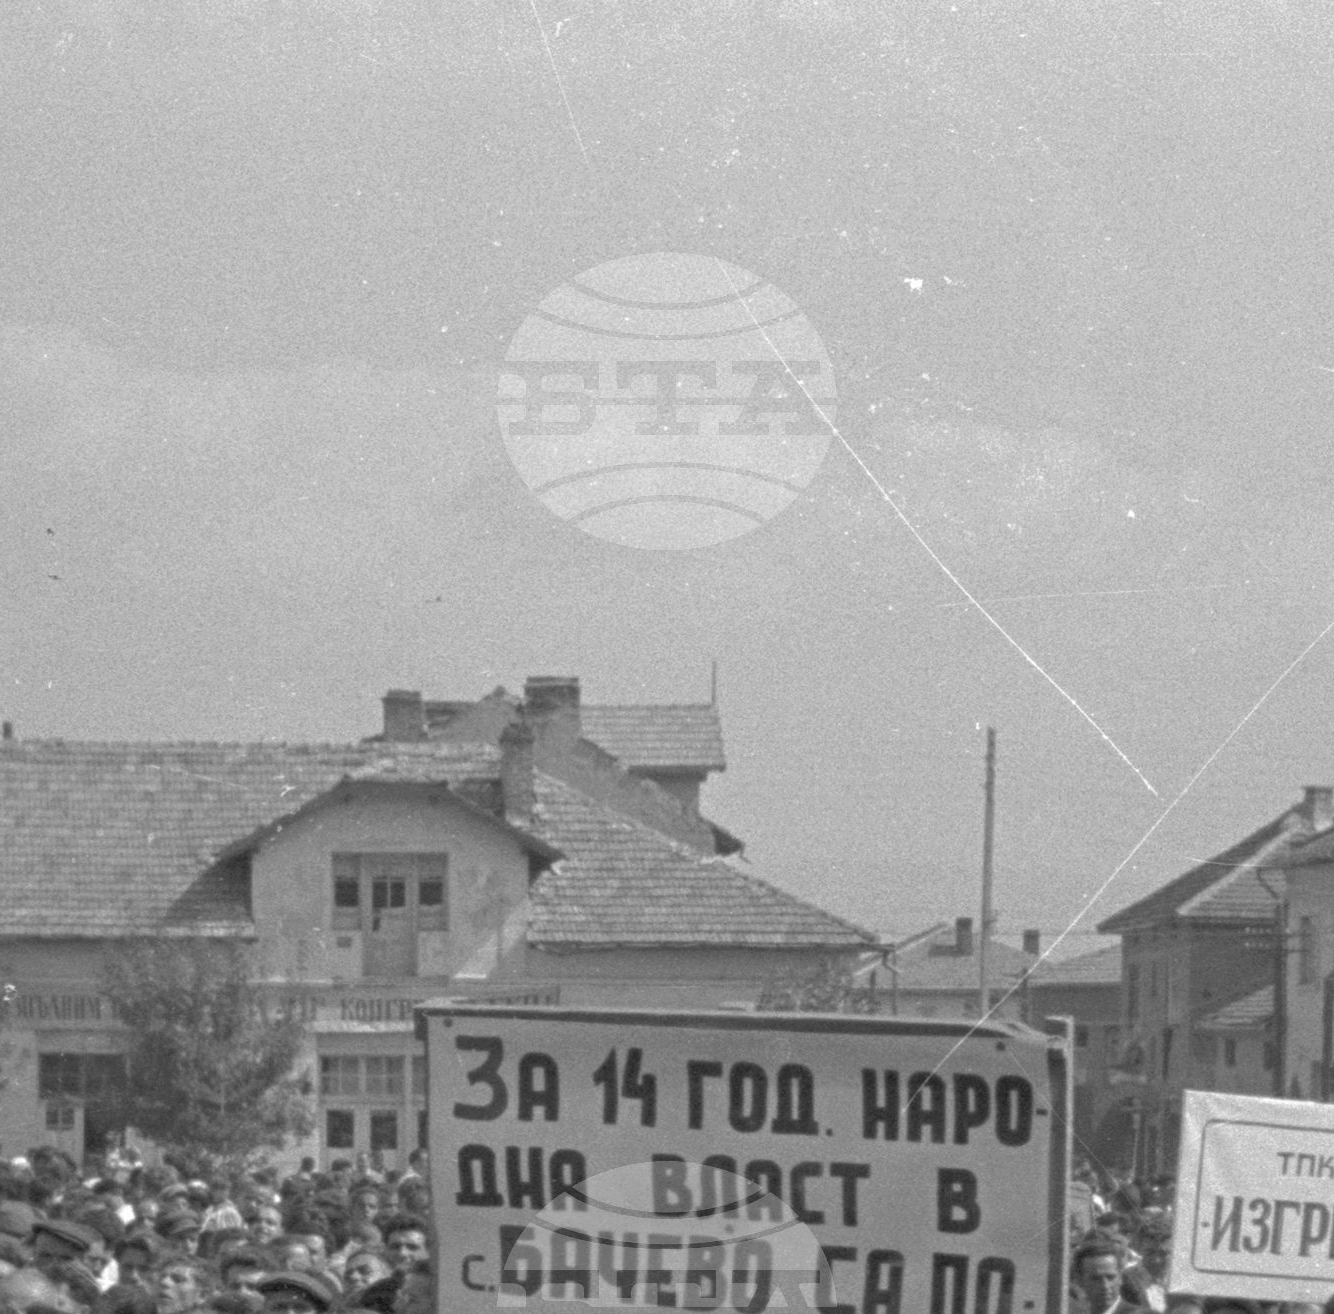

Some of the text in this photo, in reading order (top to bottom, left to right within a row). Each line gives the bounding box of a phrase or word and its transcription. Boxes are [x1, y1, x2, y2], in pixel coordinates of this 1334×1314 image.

[453, 1035, 1048, 1147] ЗА 14 ГОД. НАРО-
[456, 1143, 980, 1234] ДНА ВЛАСТ В
[1277, 1152, 1334, 1179] ТПК
[499, 1225, 772, 1314] БАЧЕВО
